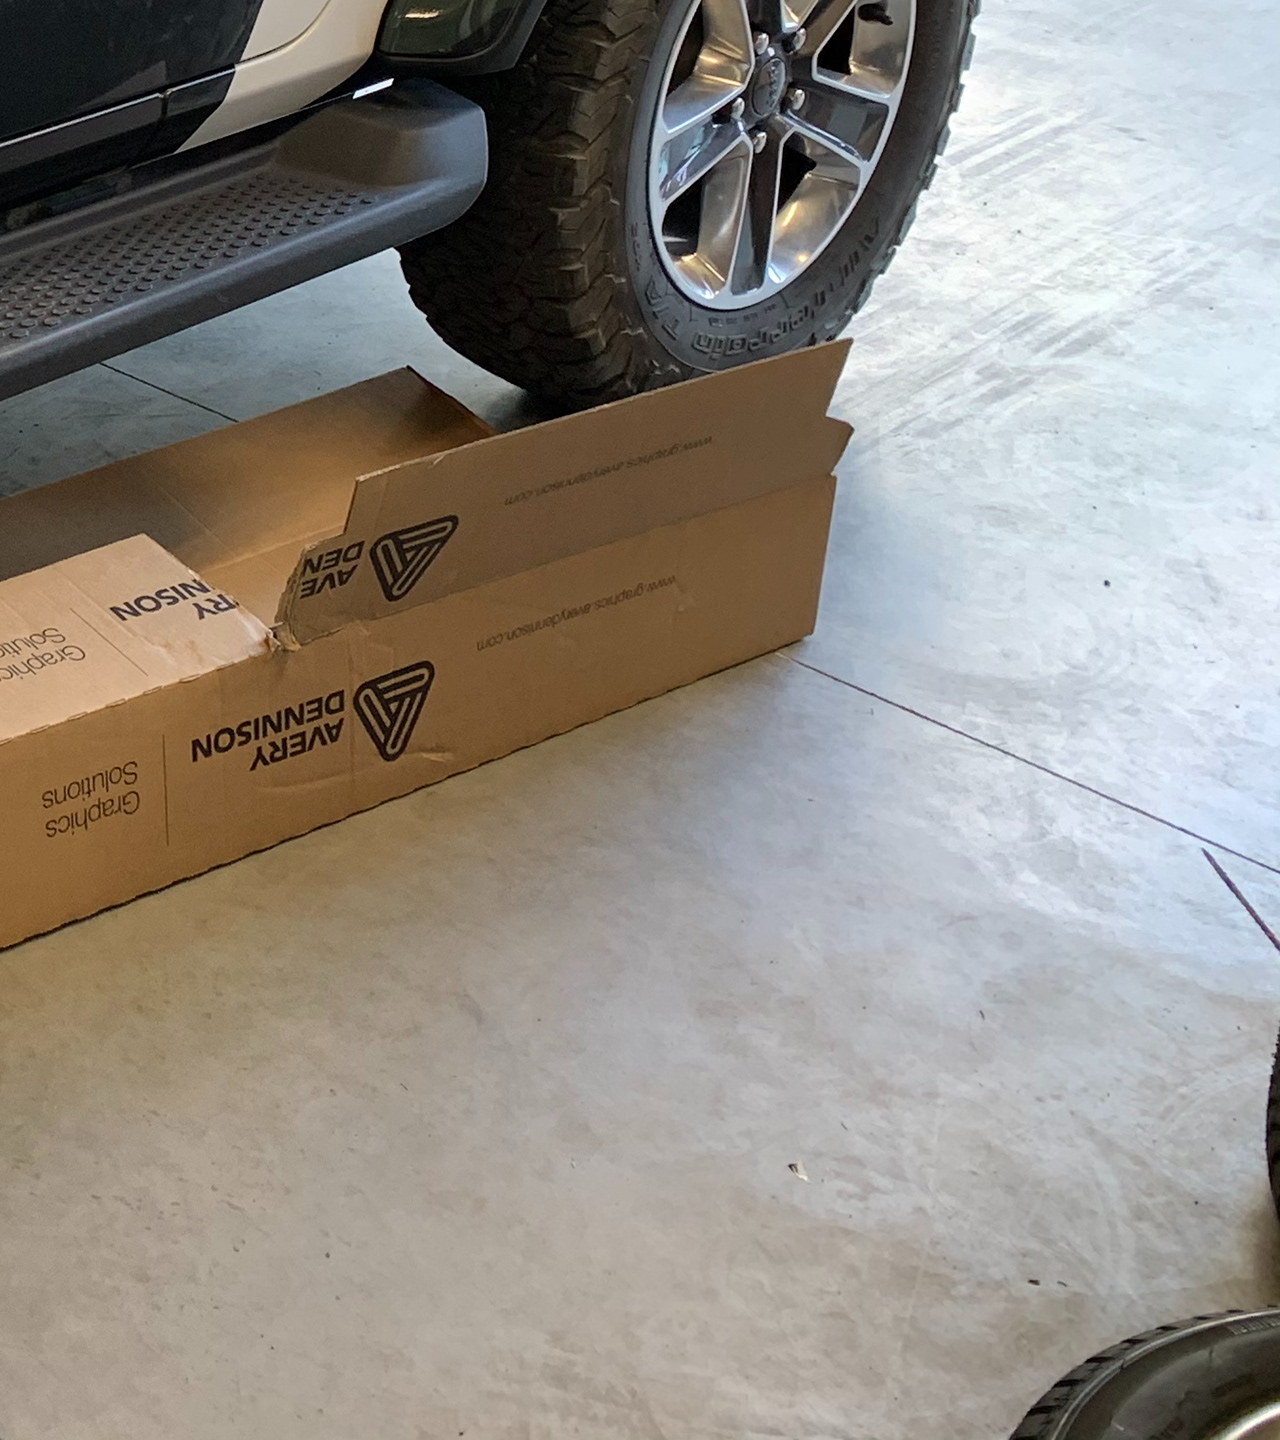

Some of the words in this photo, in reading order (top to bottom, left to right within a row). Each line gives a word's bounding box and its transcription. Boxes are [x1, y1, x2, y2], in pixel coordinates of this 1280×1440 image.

[300, 564, 358, 599] AVE
[303, 541, 365, 576] DEN
[109, 579, 211, 621] NISON
[191, 689, 345, 762] DENNISON
[249, 718, 345, 771] AVERY
[42, 761, 138, 809] Solutions
[45, 791, 140, 838] Graphics
